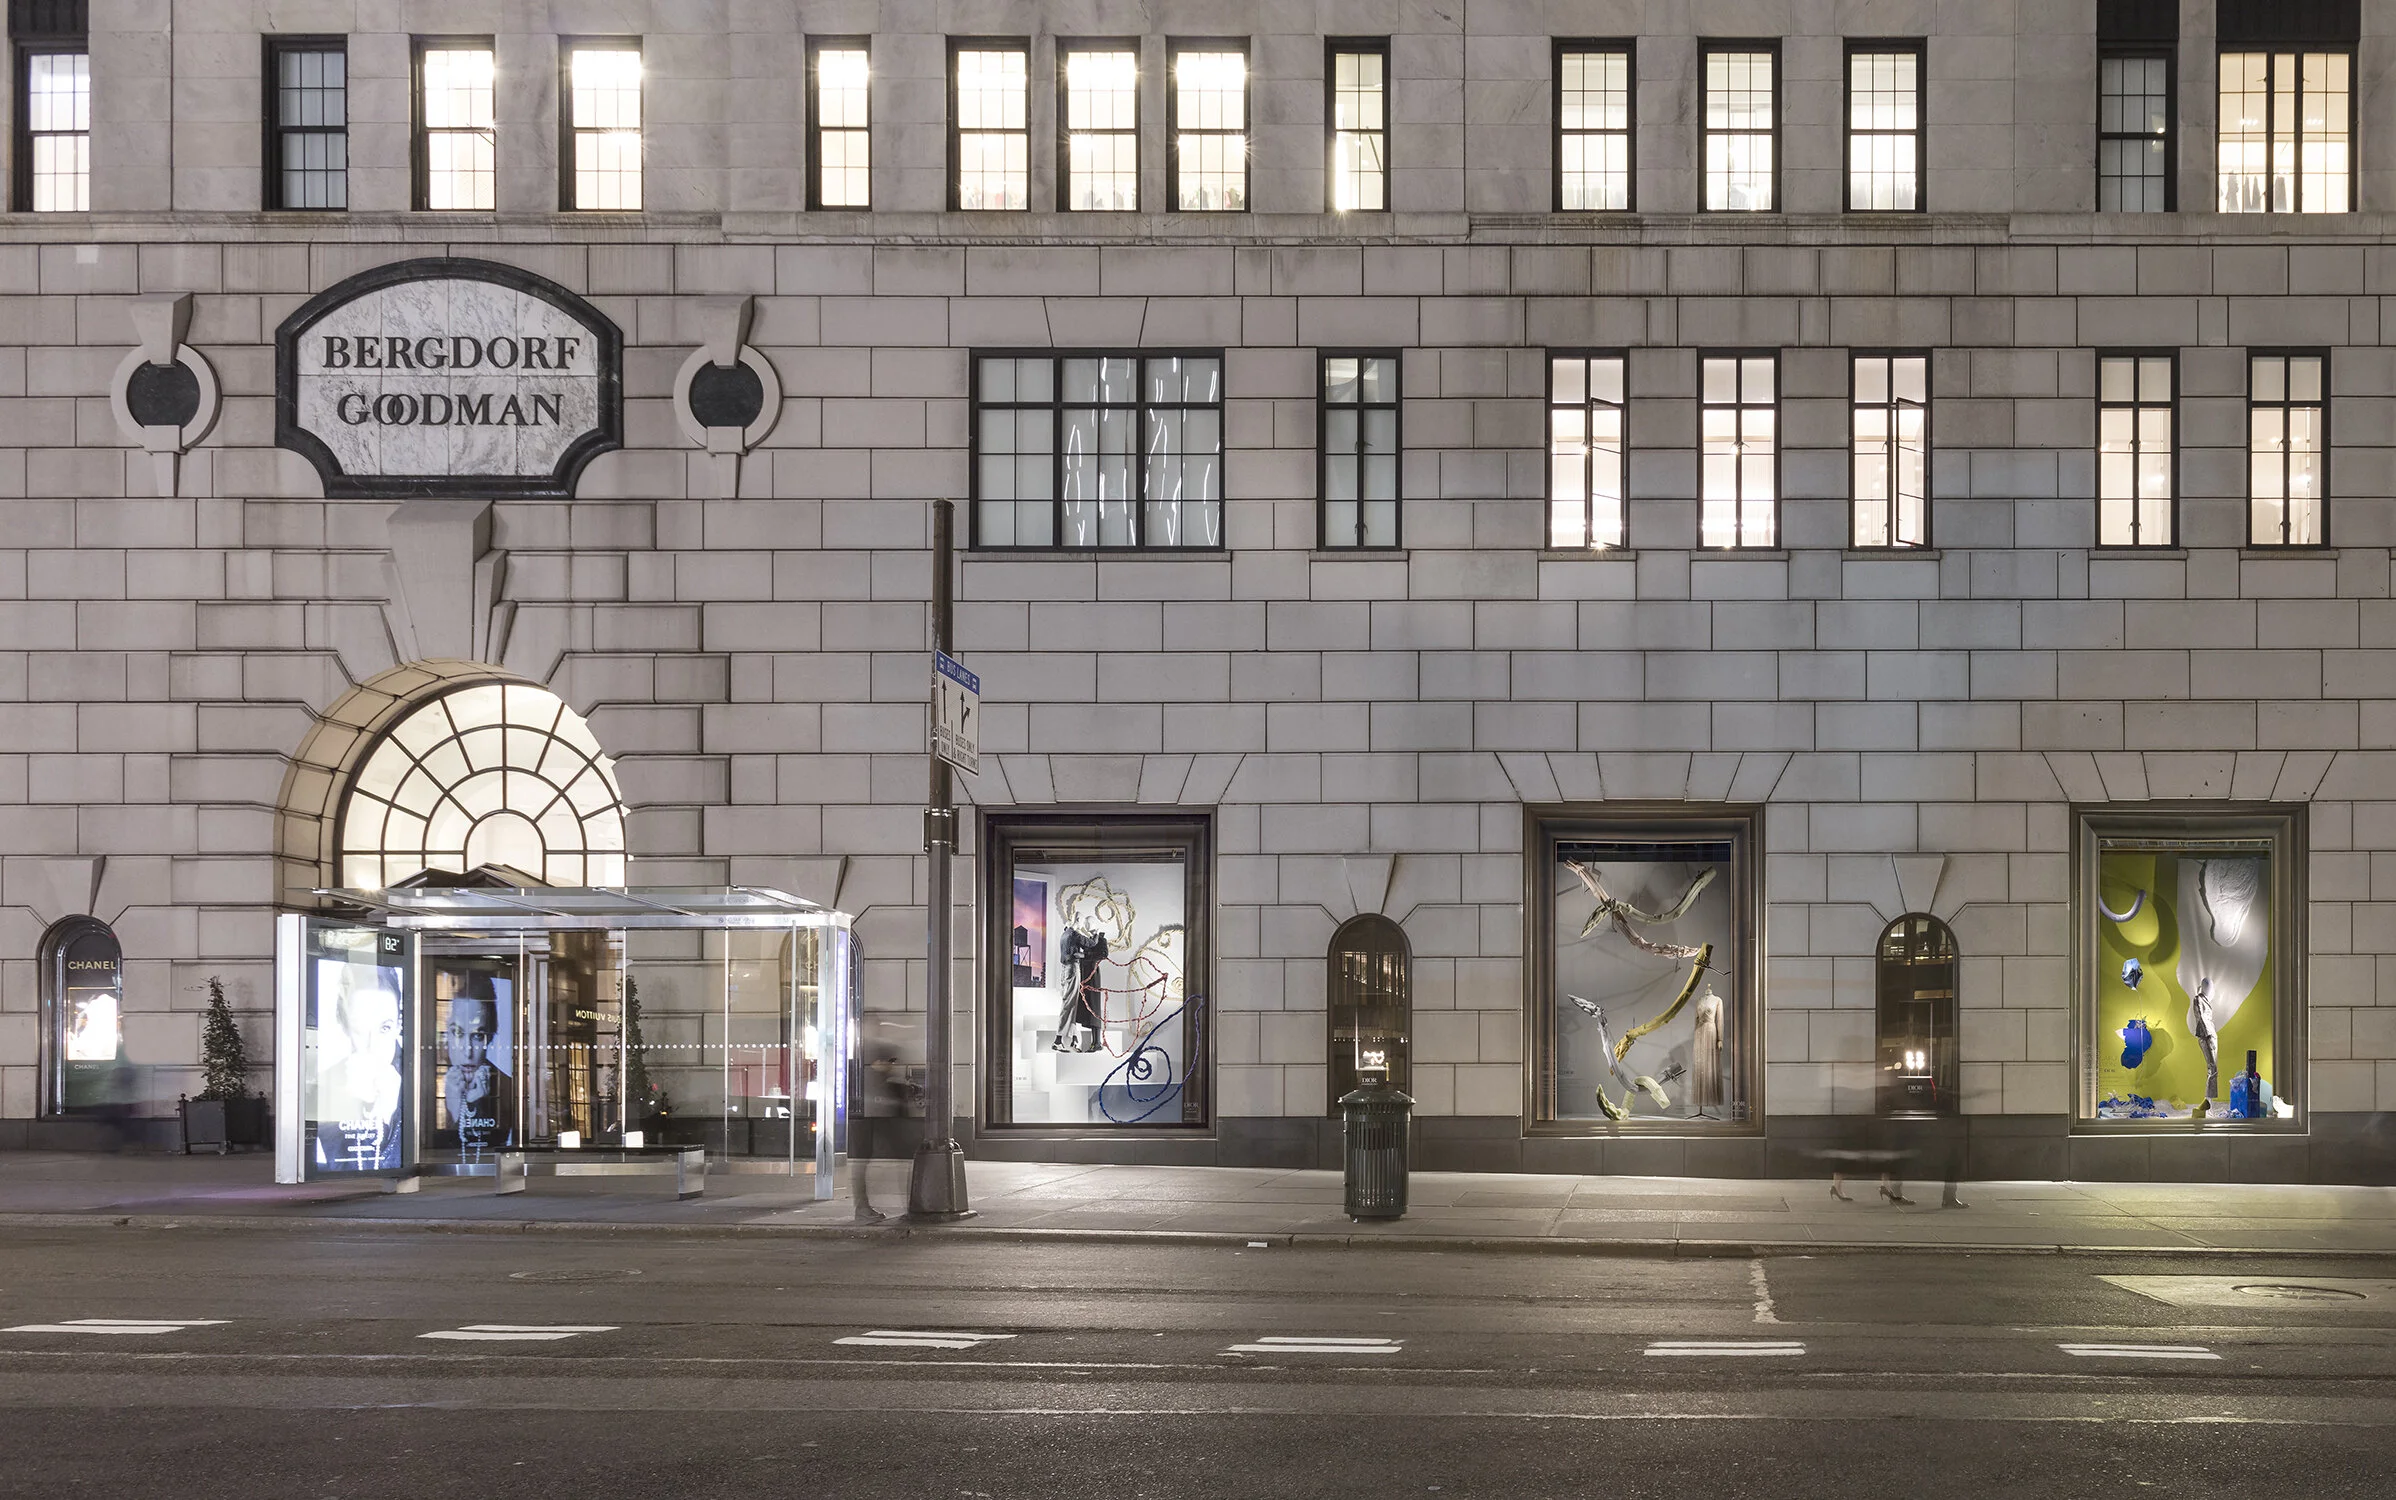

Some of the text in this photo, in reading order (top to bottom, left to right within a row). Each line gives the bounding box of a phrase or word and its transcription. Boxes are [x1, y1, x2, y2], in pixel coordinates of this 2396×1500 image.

[322, 336, 580, 369] BERGDORF
[336, 393, 564, 426] GOODMAN
[946, 661, 970, 685] BUS LANES
[68, 961, 117, 970] CHANEL
